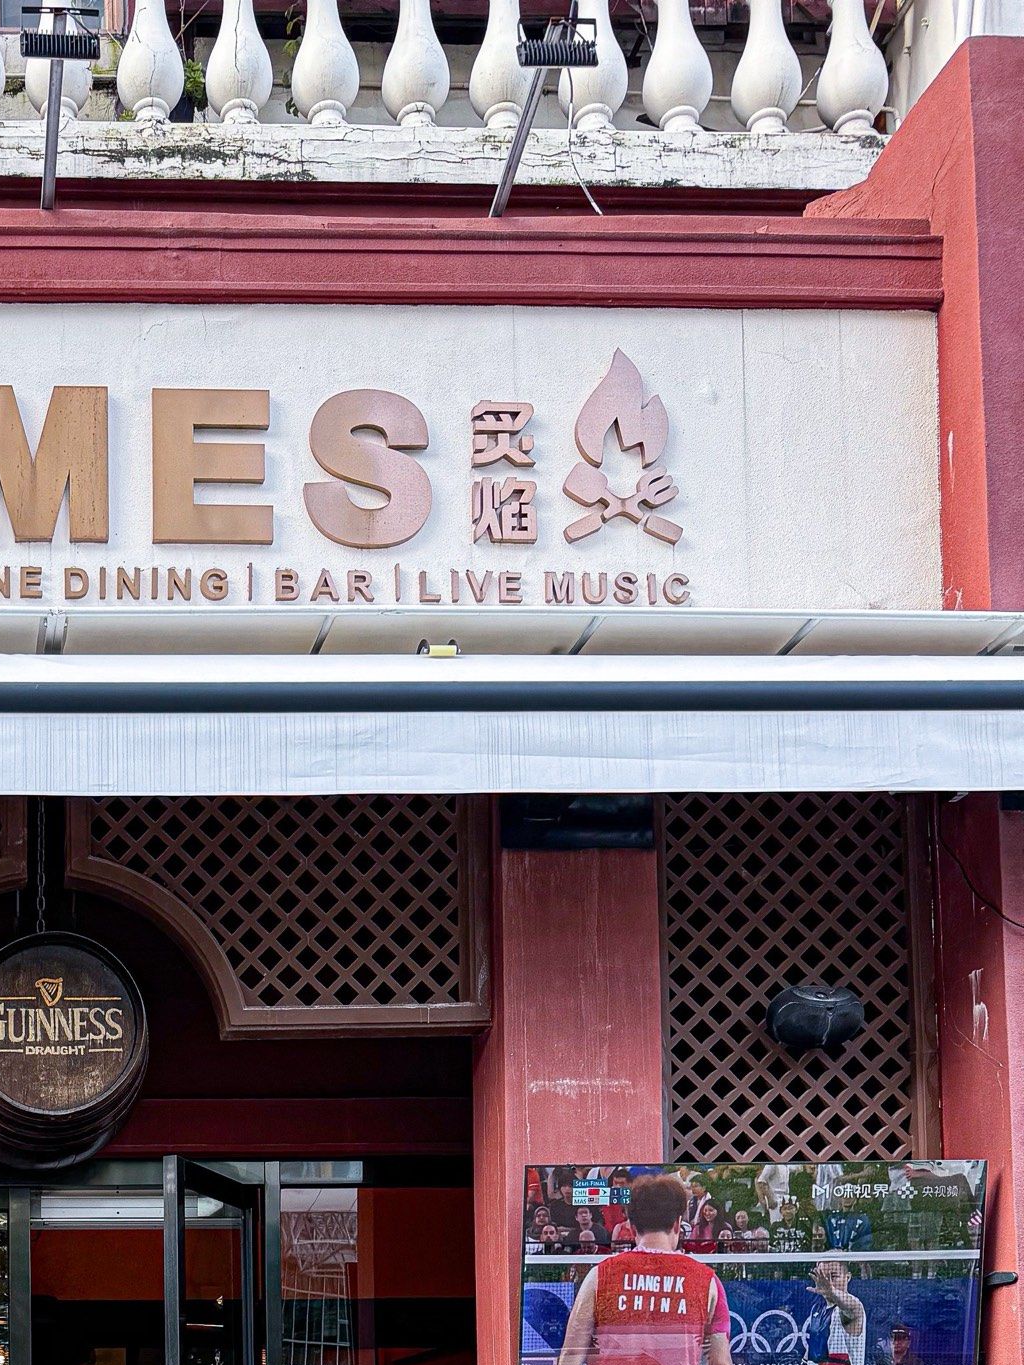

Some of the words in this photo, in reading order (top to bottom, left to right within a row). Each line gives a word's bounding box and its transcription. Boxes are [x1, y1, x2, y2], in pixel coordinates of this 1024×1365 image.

[64, 567, 230, 601] DINING
[275, 569, 374, 603] BAR
[419, 570, 524, 604] LIVE
[544, 571, 691, 606] MUSIC
[25, 1045, 86, 1056] DRAUGHT
[921, 1185, 960, 1198] 央视频
[623, 1273, 661, 1293] LIANG
[663, 1275, 685, 1294] WK
[618, 1294, 687, 1315] CHINA
